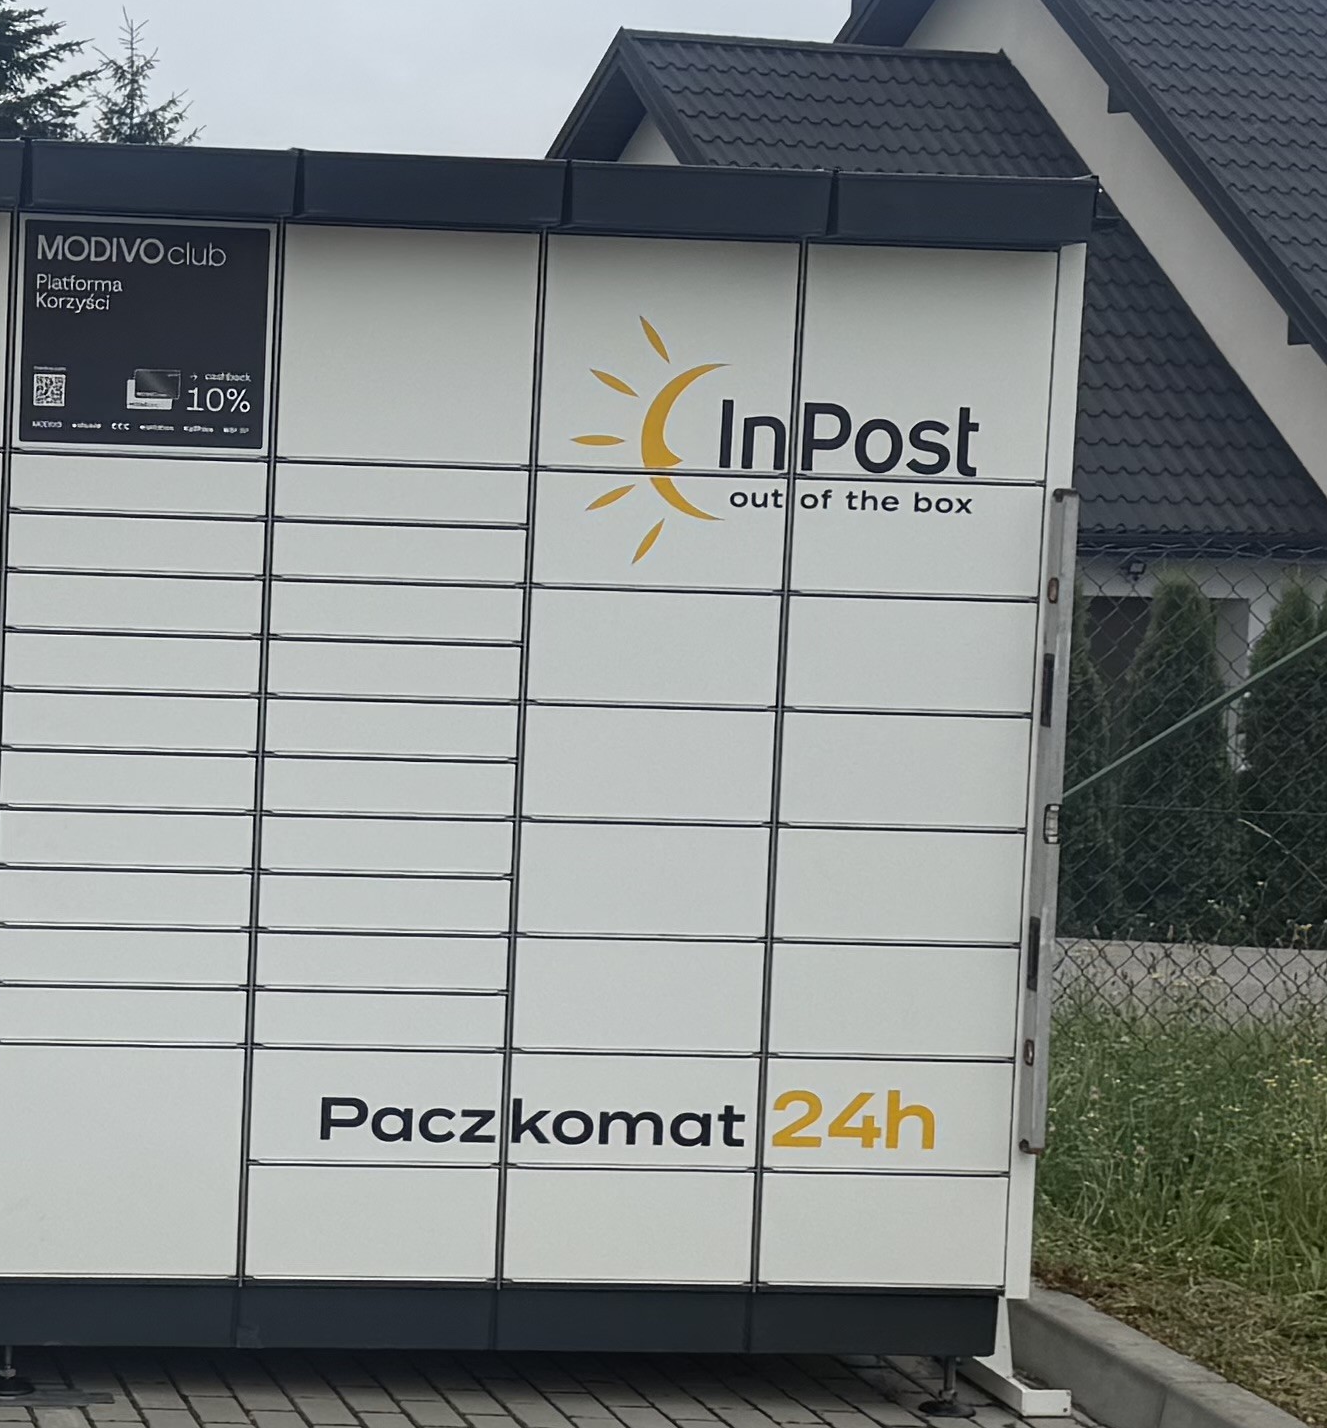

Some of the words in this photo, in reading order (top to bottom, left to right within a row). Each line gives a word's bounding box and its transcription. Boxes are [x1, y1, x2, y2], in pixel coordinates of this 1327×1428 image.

[37, 234, 165, 265] MODIVO
[167, 242, 227, 267] club
[35, 273, 123, 292] Platforma
[35, 291, 110, 313] Korzyści
[186, 386, 251, 413] 10%
[718, 399, 980, 477] InPost
[729, 489, 783, 510] out
[800, 489, 833, 510] of
[846, 490, 900, 512] the
[912, 491, 973, 515] box
[319, 1095, 746, 1149] Paczkomat
[770, 1089, 935, 1151] 24h
